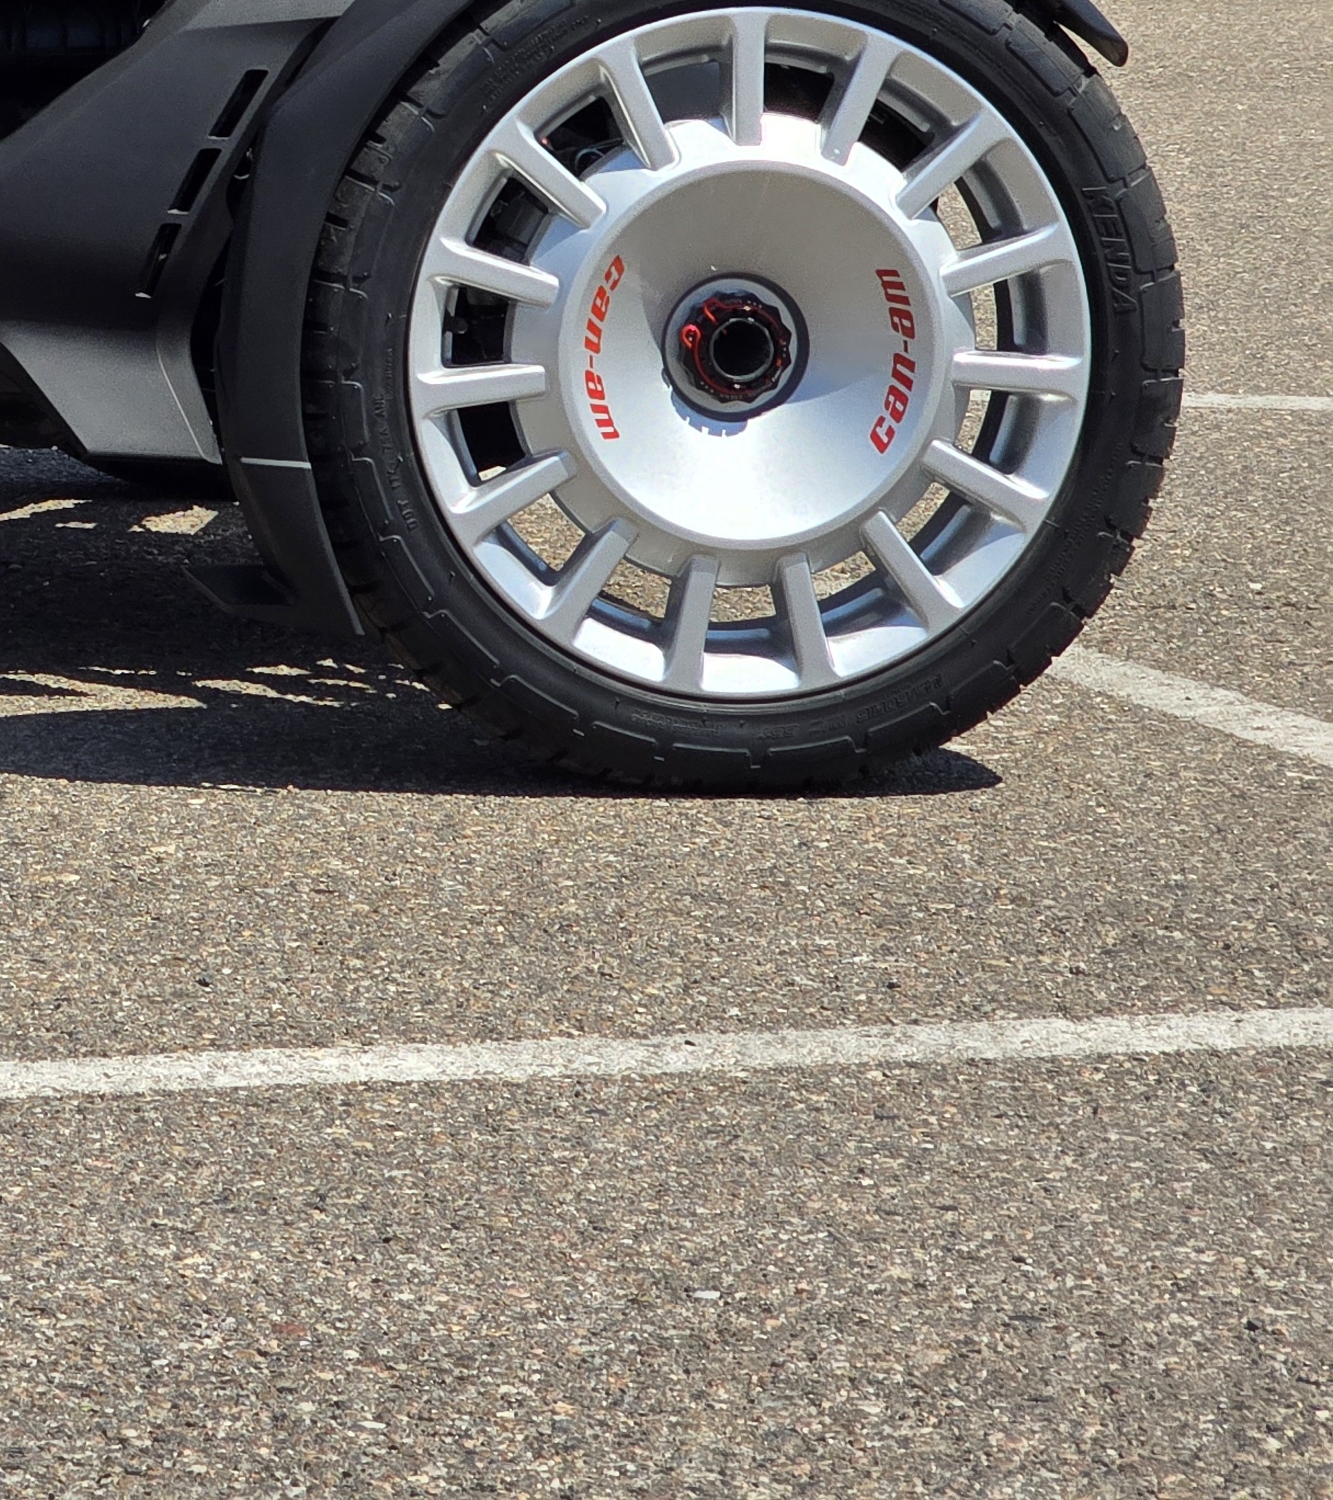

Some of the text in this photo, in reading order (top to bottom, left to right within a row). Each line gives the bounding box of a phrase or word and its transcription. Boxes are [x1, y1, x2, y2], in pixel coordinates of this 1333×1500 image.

[1081, 186, 1138, 312] KENDA
[584, 254, 626, 441] can-am
[869, 269, 916, 455] can-am
